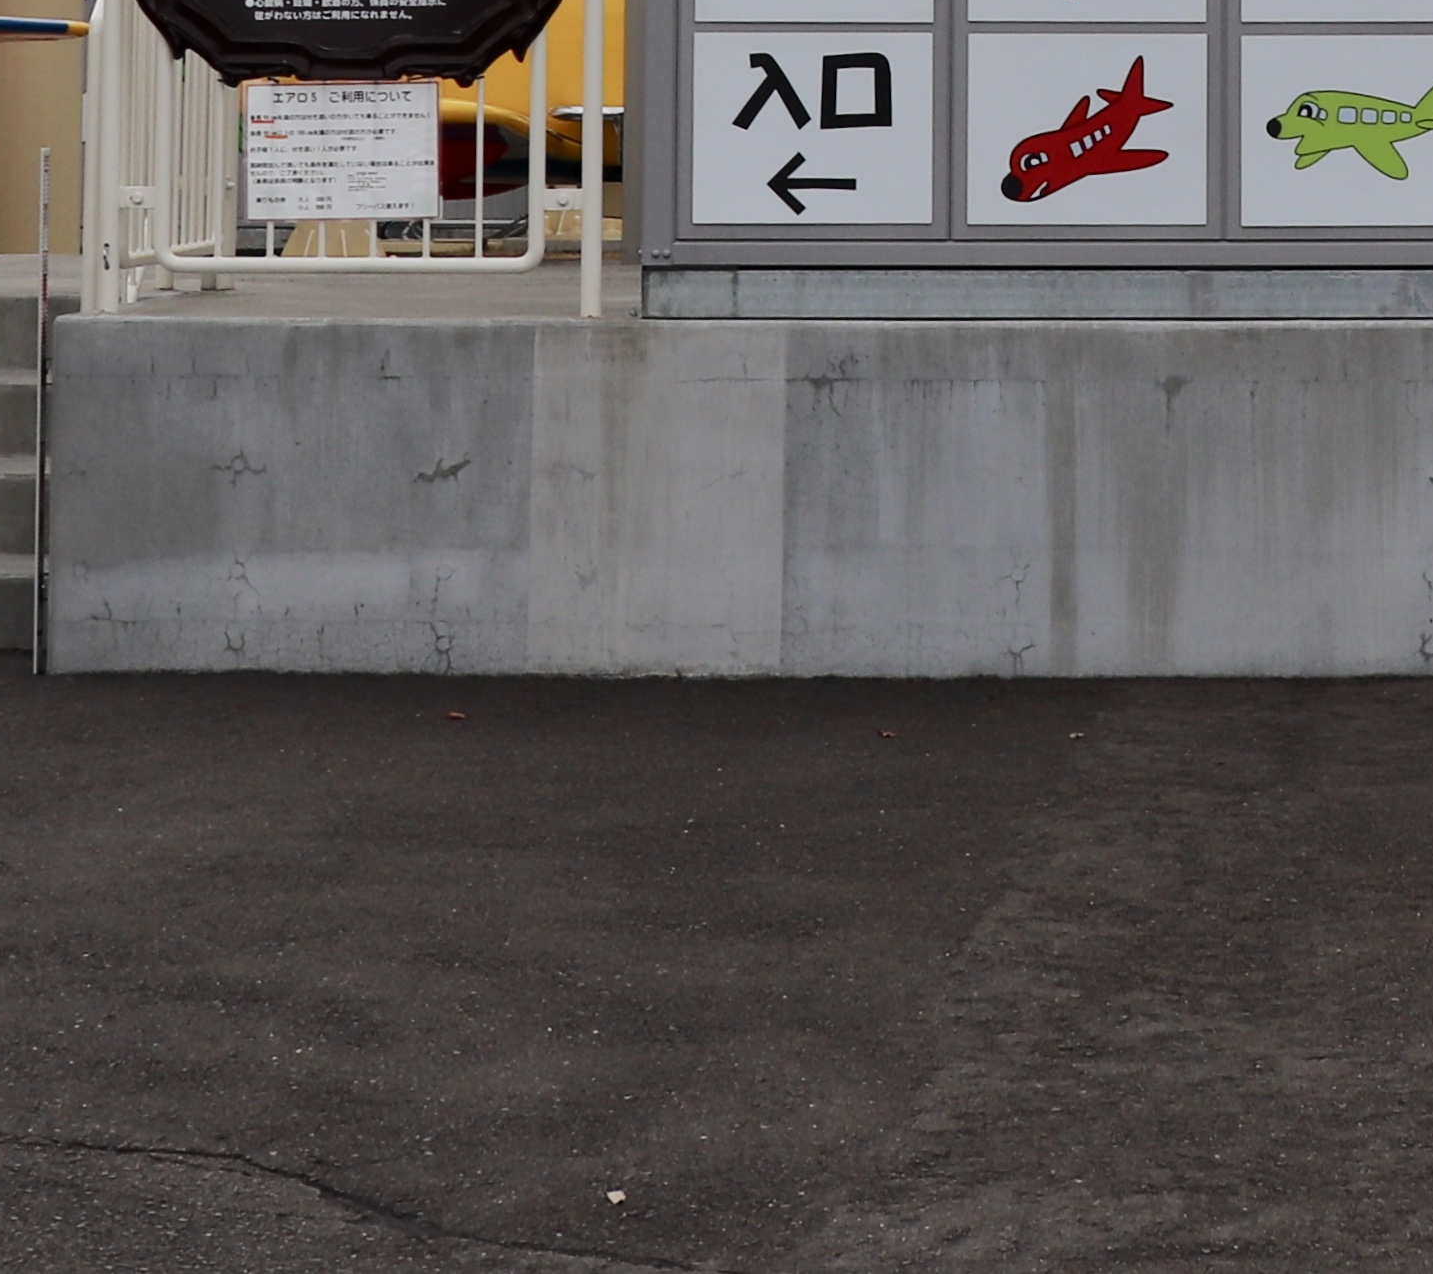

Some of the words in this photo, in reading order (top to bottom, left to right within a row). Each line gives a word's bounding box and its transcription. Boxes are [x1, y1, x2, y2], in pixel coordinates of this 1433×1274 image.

[329, 90, 412, 103] ご利用について
[733, 52, 893, 130] 入口
